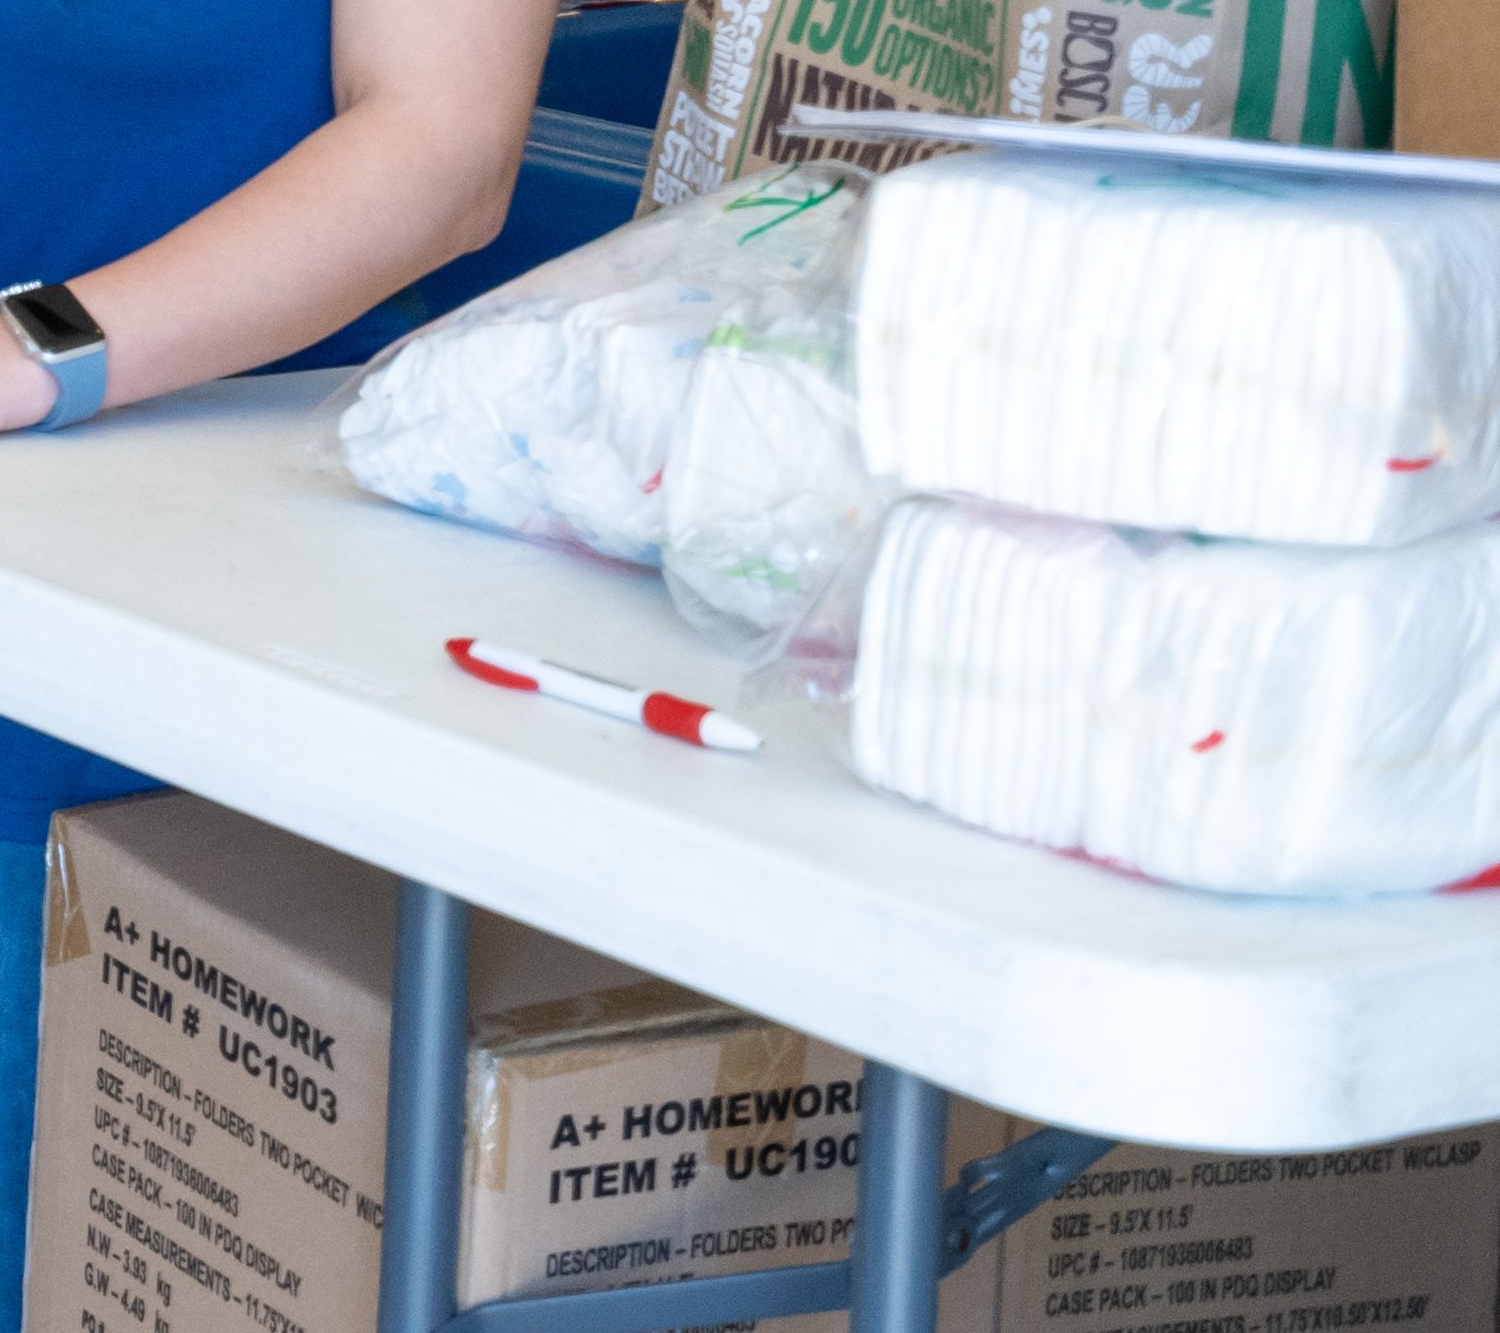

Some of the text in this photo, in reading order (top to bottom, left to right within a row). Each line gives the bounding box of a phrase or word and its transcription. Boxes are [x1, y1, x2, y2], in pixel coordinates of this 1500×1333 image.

[873, 23, 994, 113] OPTIONS?
[104, 906, 336, 1071] A+ HOMEWORK
[102, 953, 338, 1126] ITEM # UC1903
[96, 1066, 124, 1103] SIZE
[95, 1105, 119, 1140] UPC
[99, 1029, 181, 1101] DESCRIPTION
[194, 1090, 255, 1148] FOLDERS
[260, 1131, 290, 1170] TWO
[293, 1148, 349, 1209] POCKET
[550, 1114, 606, 1151] A+
[548, 1132, 862, 1204] ITEM # UC190
[1053, 1166, 1172, 1201] DESCRIPTION
[1191, 1156, 1273, 1189] FOLDERS
[1277, 1154, 1318, 1181] TWO
[1323, 1146, 1396, 1177] POCKET
[89, 1188, 122, 1228] CASE
[125, 1208, 231, 1305] MEASUREMENTS
[92, 1144, 125, 1183] CASE
[128, 1161, 161, 1207] PACK
[175, 1198, 196, 1228] 100
[199, 1209, 212, 1238] IN
[215, 1224, 243, 1261] PDQ
[246, 1241, 304, 1299] DISPLAY
[546, 1238, 671, 1280] DESCRIPTION
[690, 1223, 777, 1261] FOLDERS
[785, 1220, 823, 1249] TWO
[1051, 1213, 1091, 1240] SIZE
[156, 1272, 171, 1307] kg
[1046, 1291, 1095, 1318] CASE
[1099, 1283, 1149, 1311] PACK
[1167, 1280, 1195, 1305] 100
[1200, 1278, 1218, 1303] IN
[1221, 1274, 1259, 1300] PDQ
[1263, 1265, 1337, 1298] DISPLAY
[1047, 1253, 1084, 1279] UPC
